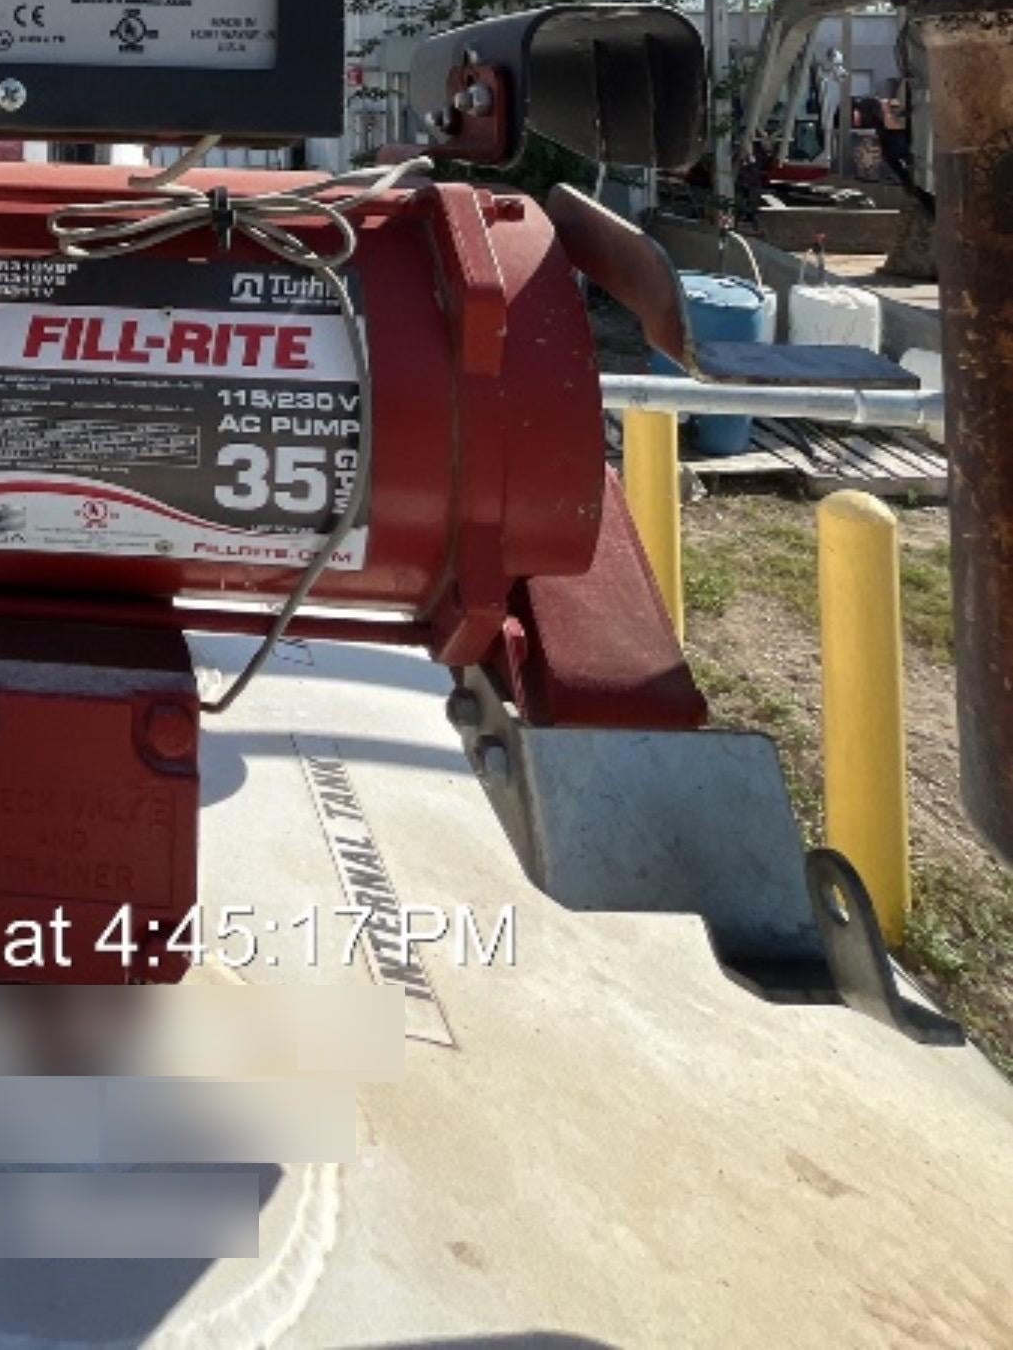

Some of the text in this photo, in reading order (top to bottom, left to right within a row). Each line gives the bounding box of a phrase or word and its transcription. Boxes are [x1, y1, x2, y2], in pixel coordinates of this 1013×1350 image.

[23, 315, 313, 369] FILL-RITE
[217, 389, 333, 411] 115/230
[339, 395, 360, 412] V
[217, 414, 360, 437] AC PUMP
[214, 443, 327, 513] 35
